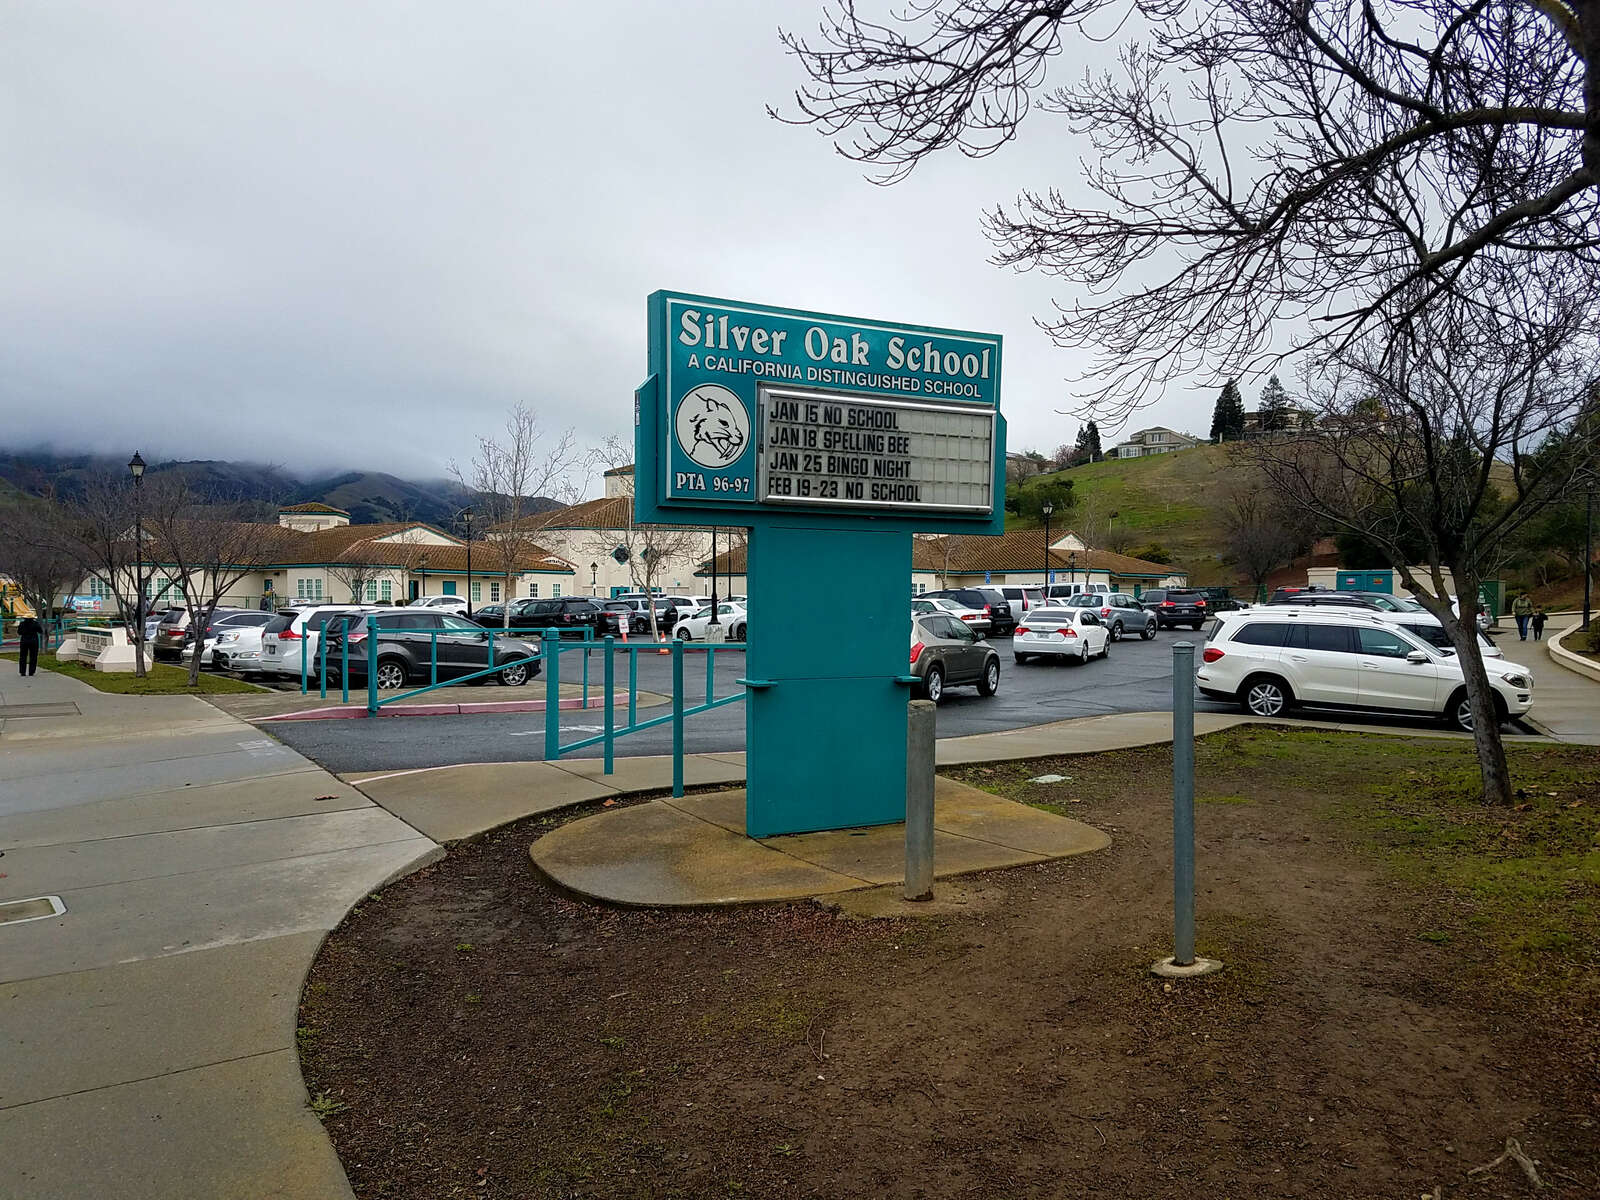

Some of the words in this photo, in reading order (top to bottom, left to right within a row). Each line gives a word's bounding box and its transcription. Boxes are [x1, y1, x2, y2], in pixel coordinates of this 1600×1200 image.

[679, 309, 787, 355] Silver
[804, 326, 870, 366] Oak
[886, 336, 990, 379] School
[688, 354, 699, 368] A
[704, 356, 802, 379] CALIFORNIA
[807, 367, 920, 391] DISTINGUISHED
[924, 379, 981, 398] SCHOOL
[770, 401, 799, 421] JAN
[805, 404, 819, 423] 15
[824, 406, 842, 425] NO
[848, 408, 899, 429] SCHOOL
[770, 426, 799, 446] JAN
[803, 429, 817, 448] 18
[823, 431, 884, 453] SPELLING
[888, 435, 909, 454] BEE
[770, 452, 799, 471] JAN
[803, 454, 822, 473] 25
[827, 456, 868, 476] BINGO
[873, 459, 911, 478] NIGHT
[676, 472, 706, 491] PTA
[713, 476, 749, 492] 96-97
[768, 477, 791, 495] FEB
[797, 479, 838, 498] 19-23
[845, 481, 864, 500] NO
[871, 483, 921, 502] SCHOOL
